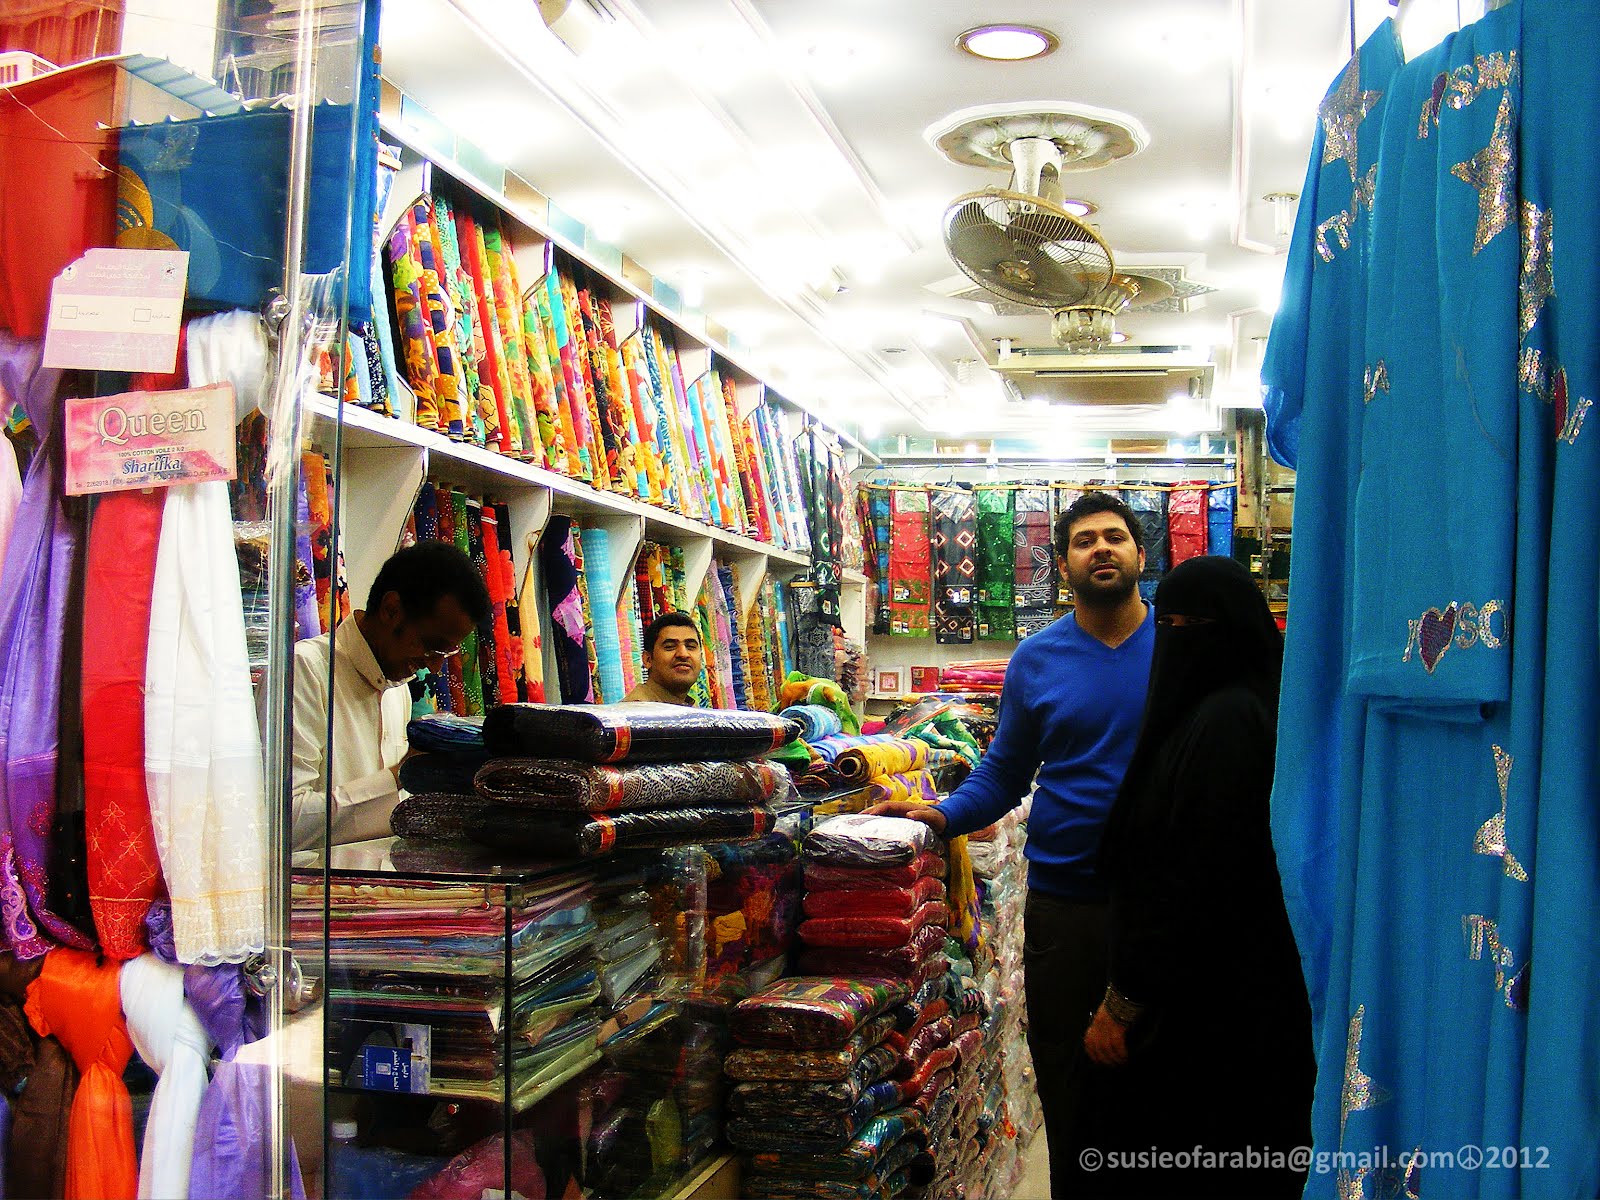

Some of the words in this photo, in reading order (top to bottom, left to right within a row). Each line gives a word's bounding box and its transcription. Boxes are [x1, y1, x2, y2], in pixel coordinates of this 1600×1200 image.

[98, 406, 206, 446] Queen
[132, 449, 155, 457] COTTON
[122, 454, 182, 475] Sharifka
